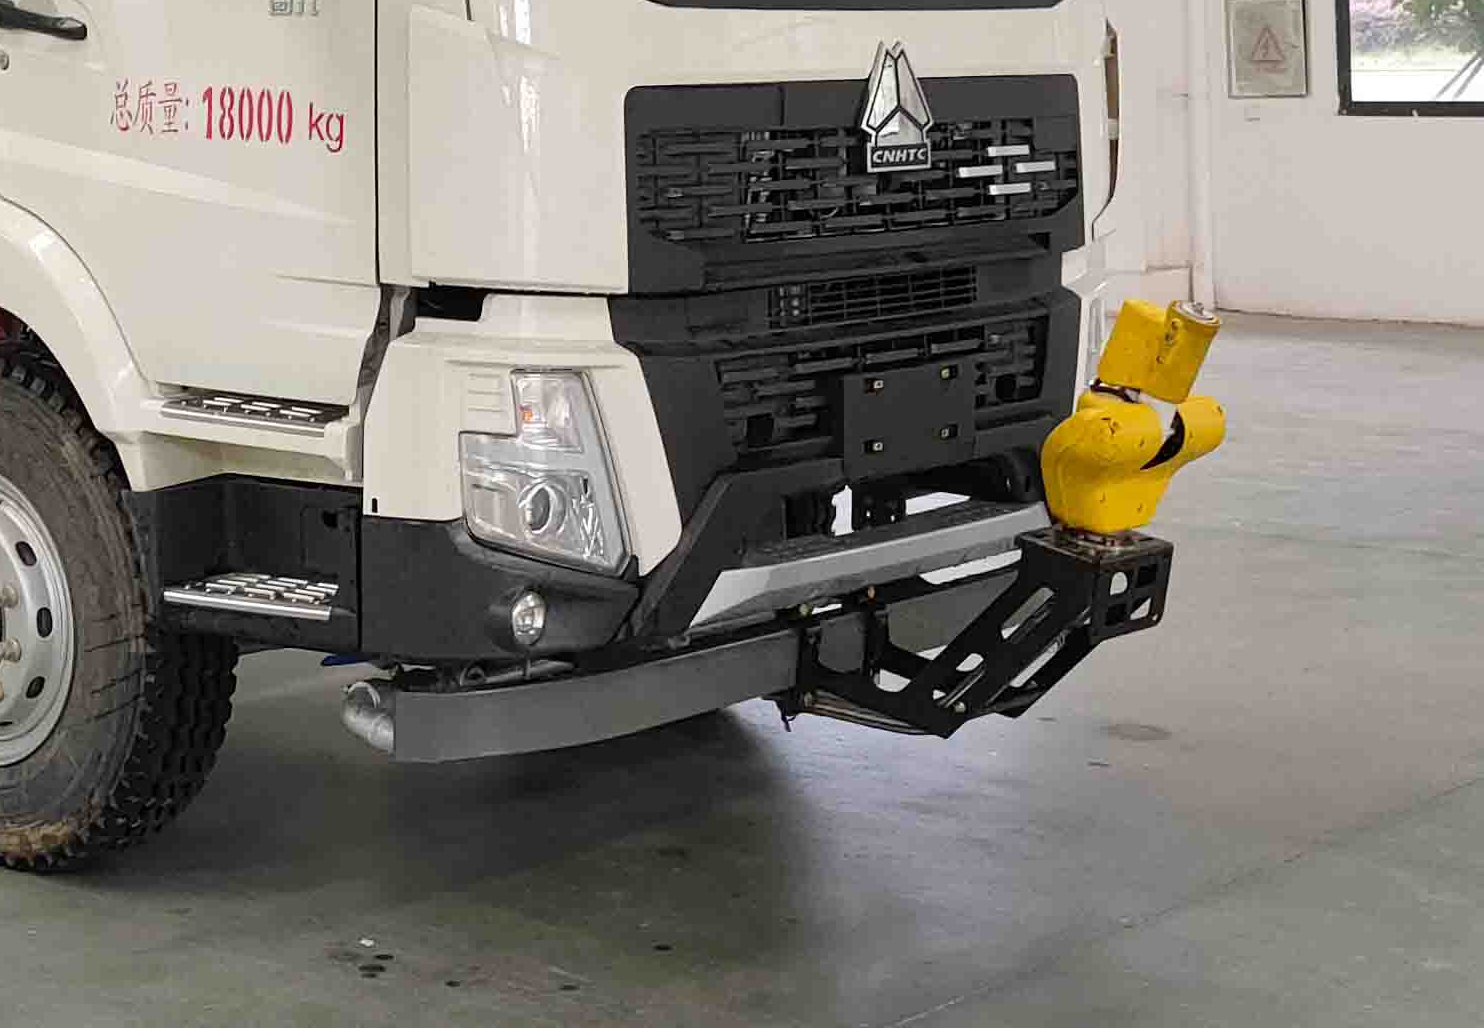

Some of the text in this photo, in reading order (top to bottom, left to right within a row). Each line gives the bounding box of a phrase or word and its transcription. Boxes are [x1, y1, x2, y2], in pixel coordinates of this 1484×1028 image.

[202, 86, 293, 144] 18000
[308, 101, 346, 153] kg
[872, 147, 927, 163] CNHTC
